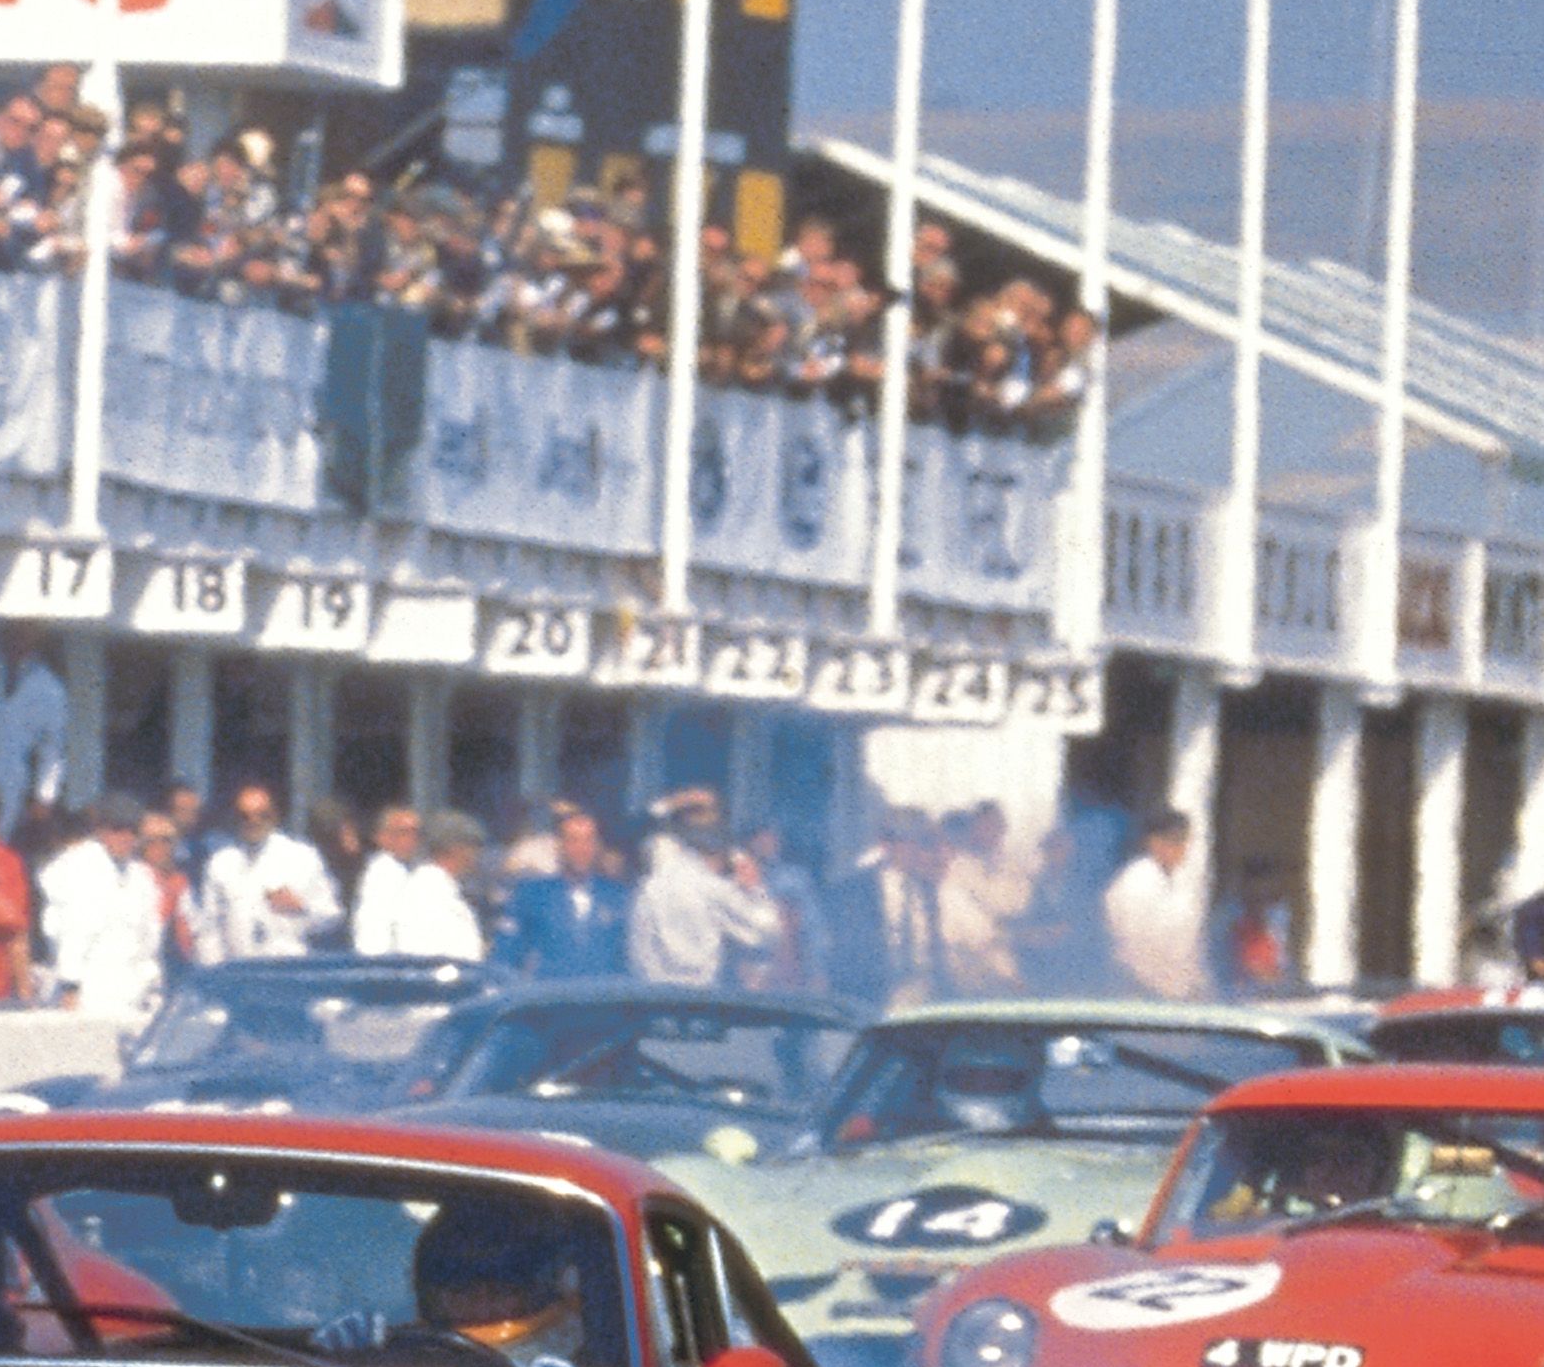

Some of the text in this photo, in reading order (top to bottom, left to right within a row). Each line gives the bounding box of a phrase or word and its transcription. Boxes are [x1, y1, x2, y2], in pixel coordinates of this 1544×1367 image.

[39, 549, 92, 598] 17
[173, 566, 226, 613] 18
[302, 583, 353, 630] 19
[512, 615, 570, 656] 20
[869, 1198, 1012, 1240] 14
[1205, 1338, 1240, 1367] 4
